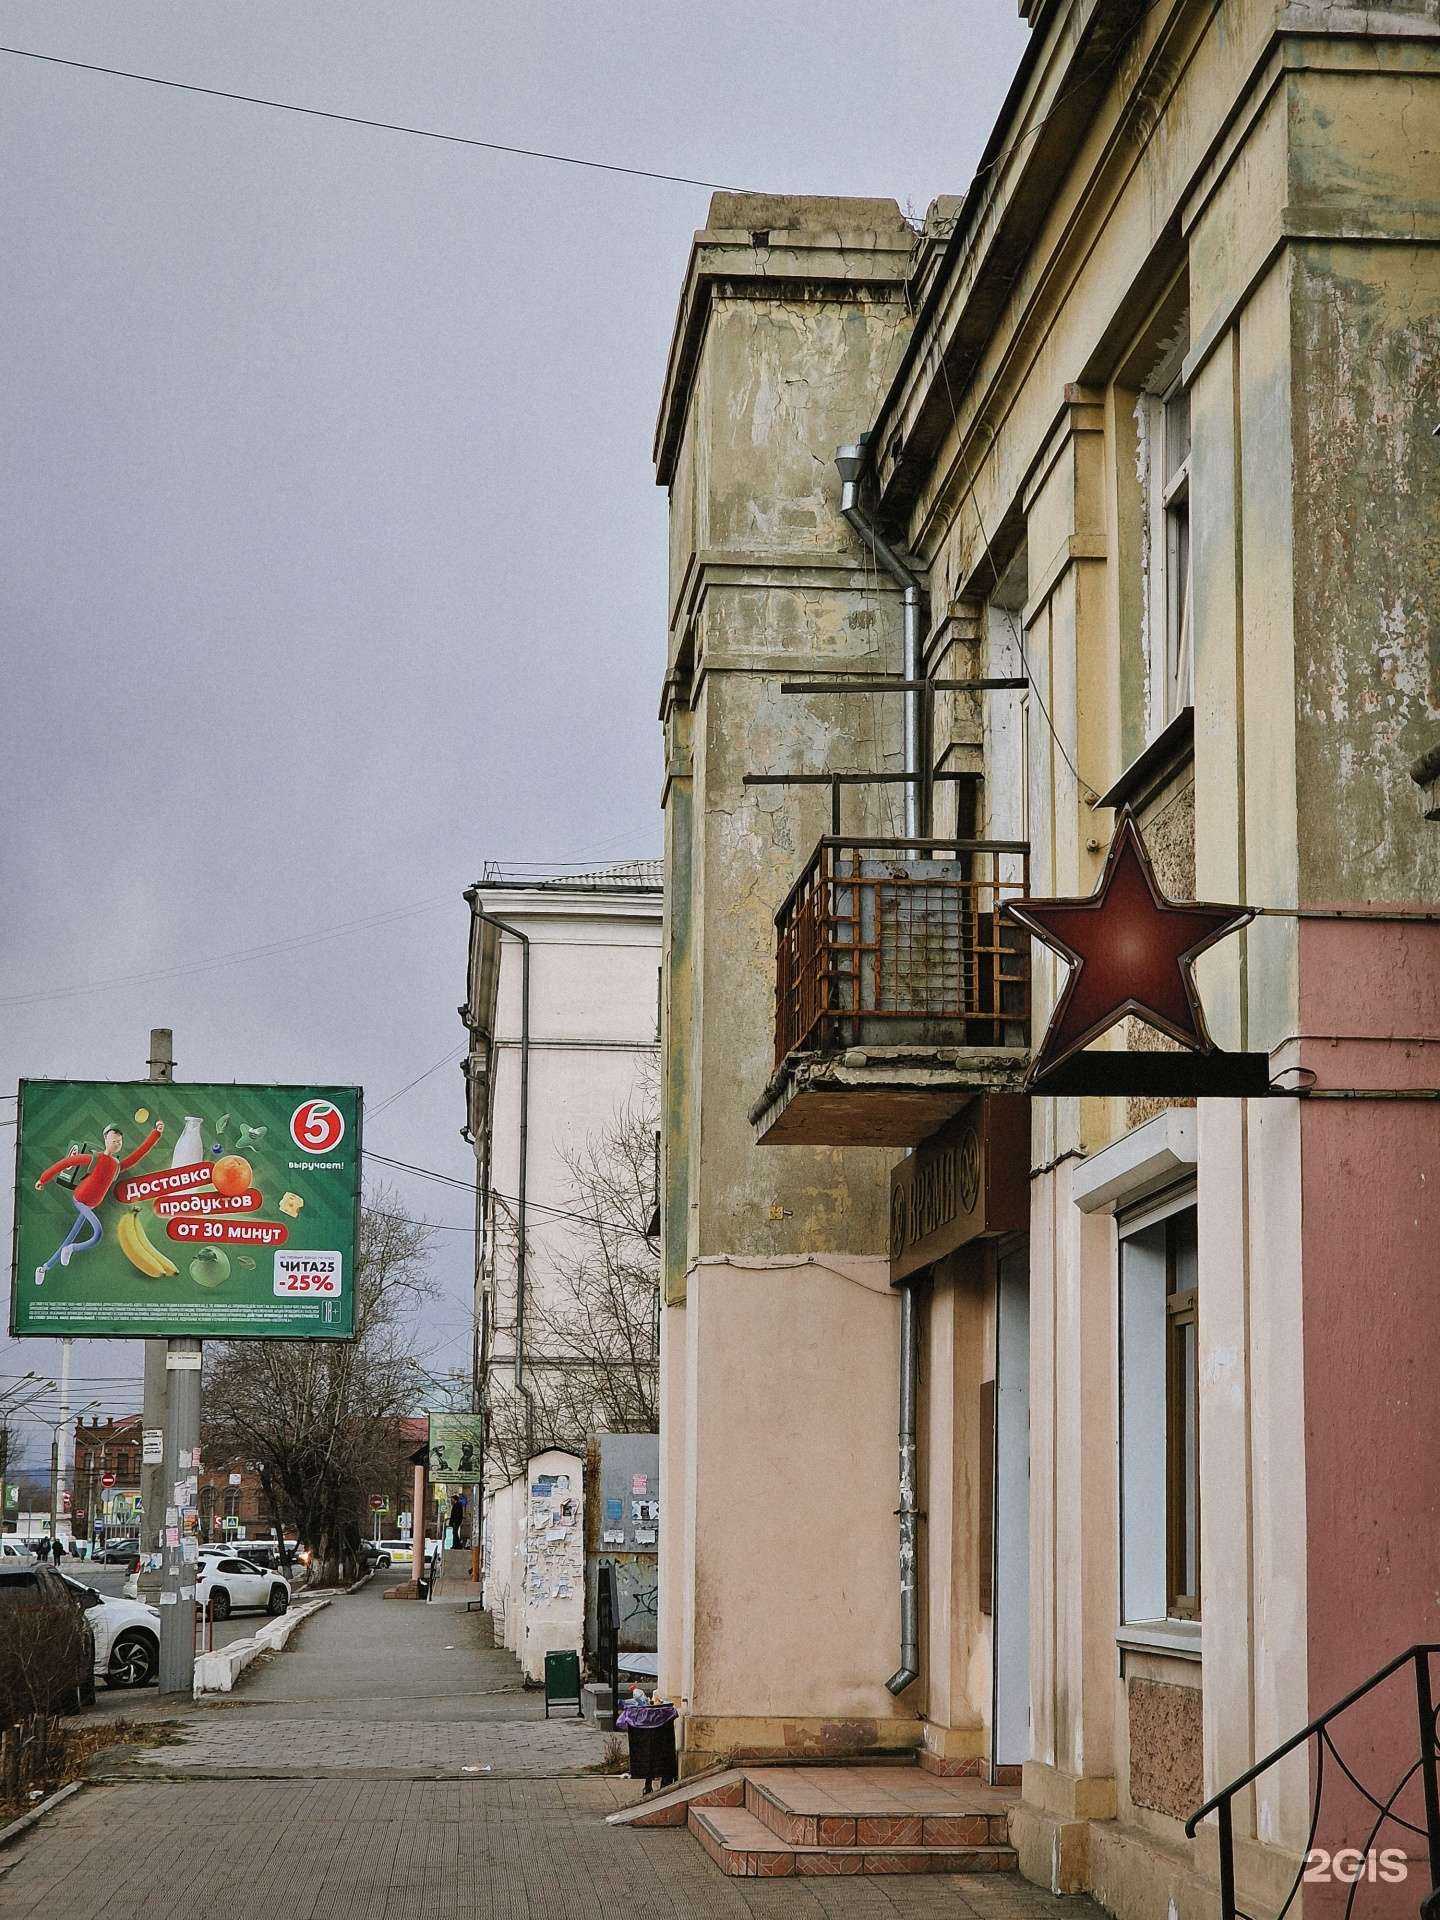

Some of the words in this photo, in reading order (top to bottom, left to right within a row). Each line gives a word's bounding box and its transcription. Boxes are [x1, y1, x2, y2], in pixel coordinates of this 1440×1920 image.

[288, 1161, 345, 1171] выручает!
[126, 1168, 210, 1200] Доставка
[159, 1194, 252, 1214] продуктов
[177, 1223, 199, 1237] от
[203, 1223, 223, 1238] 30
[227, 1225, 282, 1241] минут
[280, 1261, 335, 1273] ЧИТА25
[279, 1274, 335, 1291] -25%
[325, 1300, 340, 1323] 18+
